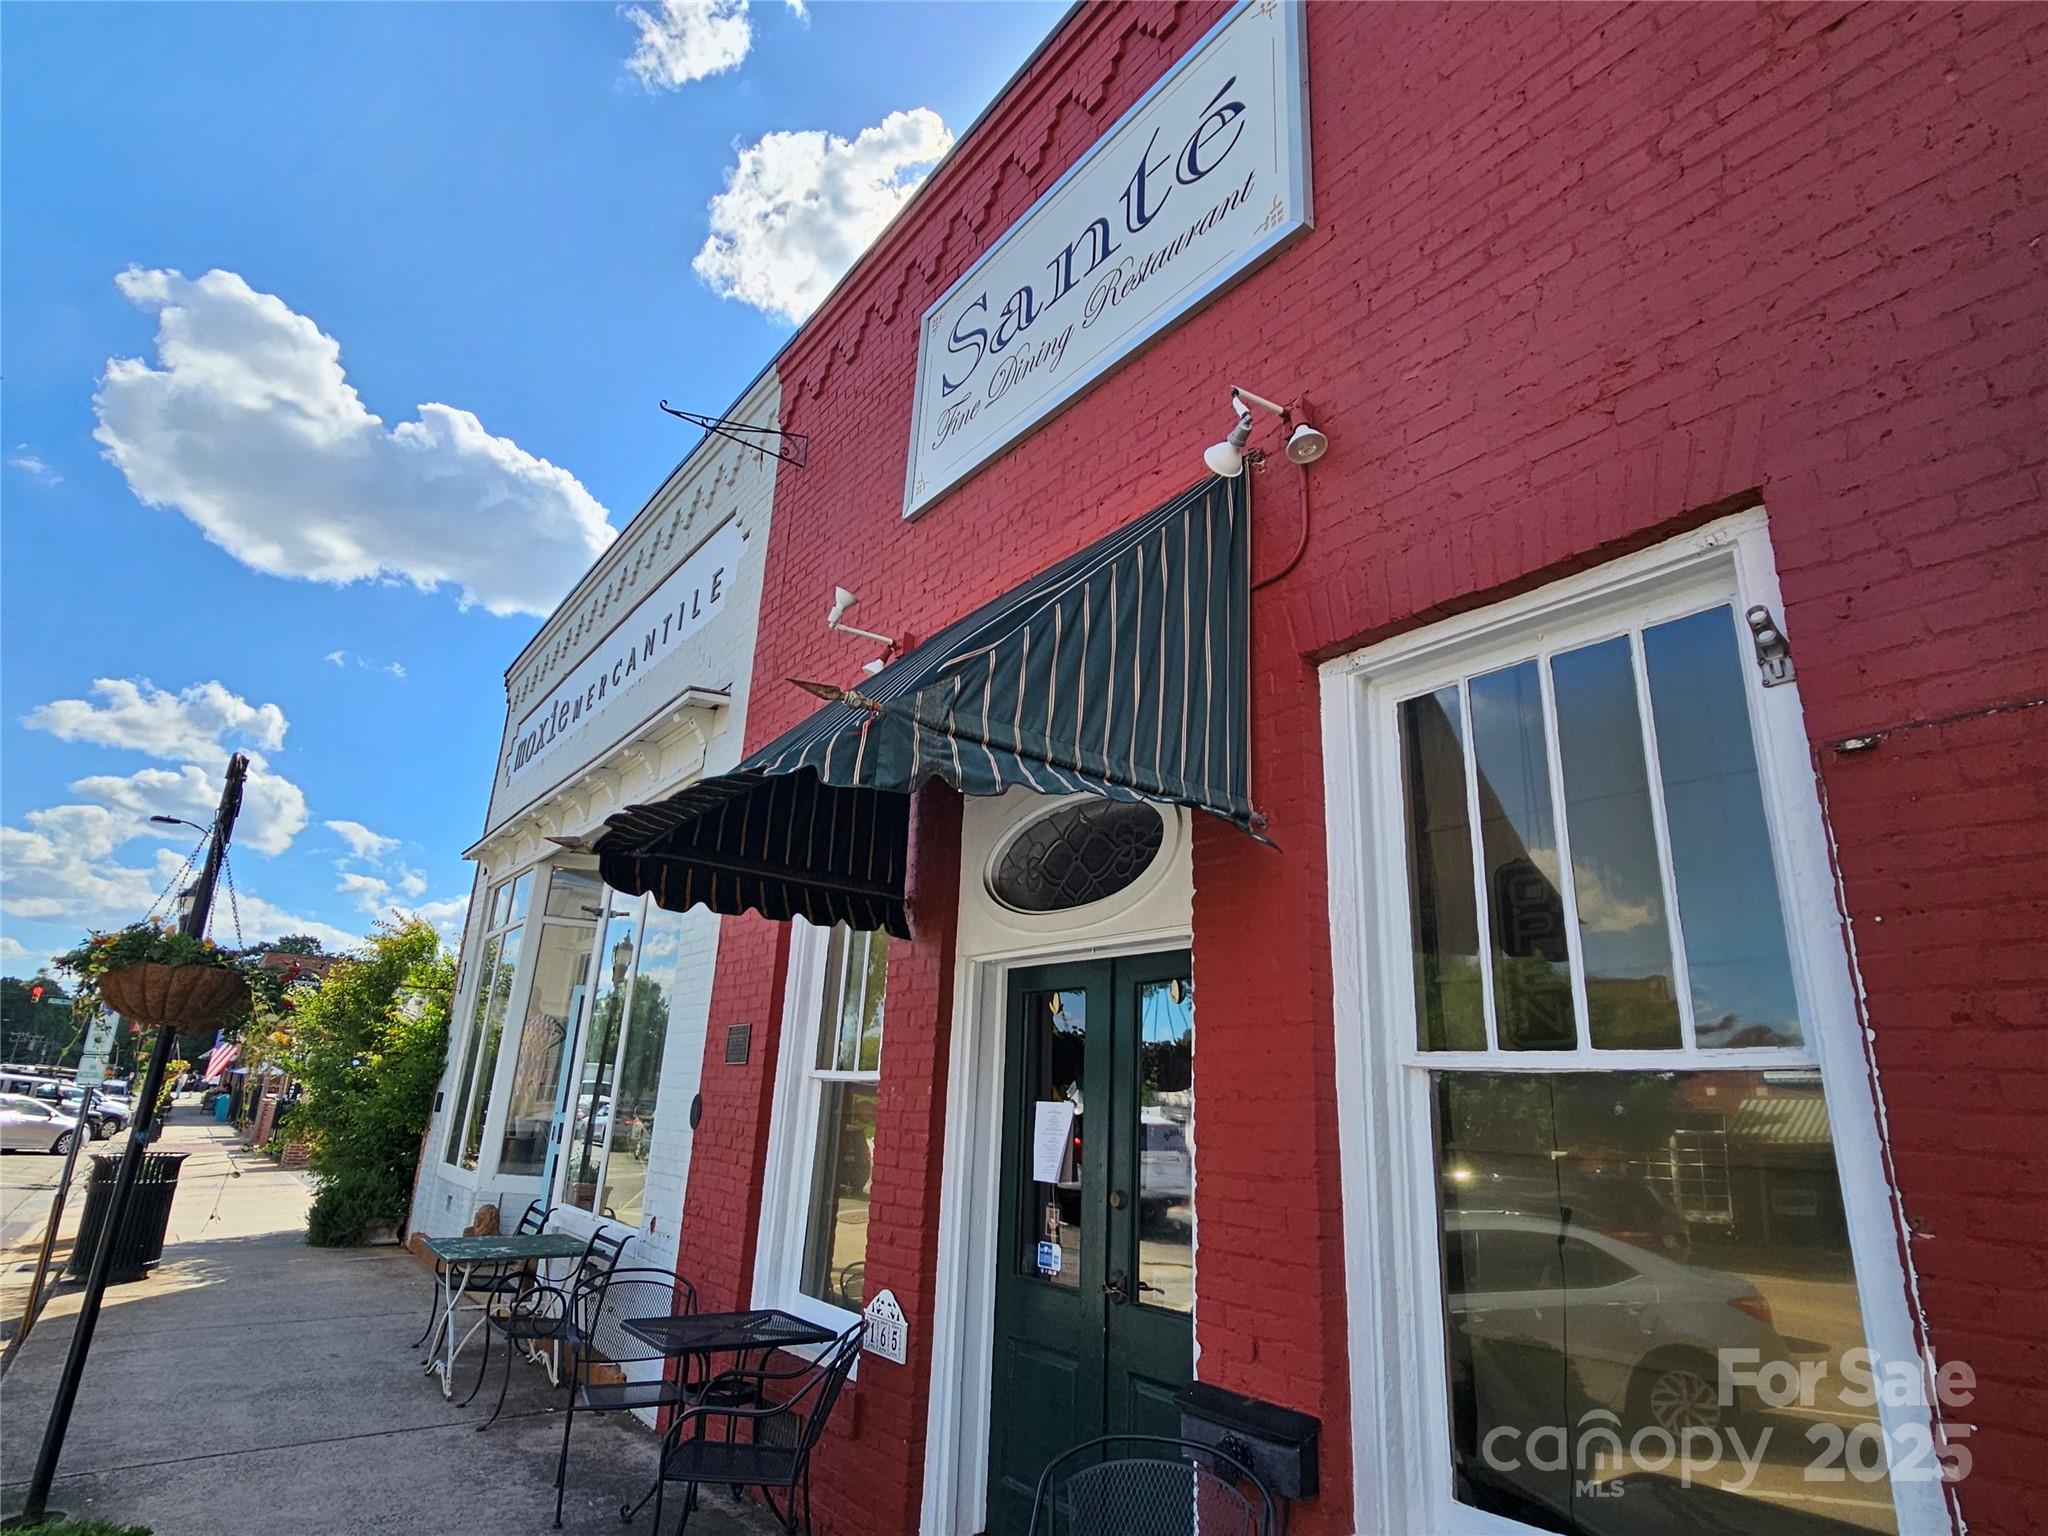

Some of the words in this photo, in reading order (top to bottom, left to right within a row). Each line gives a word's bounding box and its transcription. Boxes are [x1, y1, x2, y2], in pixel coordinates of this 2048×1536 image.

[932, 391, 981, 450] Fine
[985, 323, 1075, 409] Dining
[1083, 168, 1257, 329] Restaurant
[941, 75, 1247, 397] Santé
[572, 566, 724, 723] MERCANTILE
[870, 1322, 898, 1351] 165
